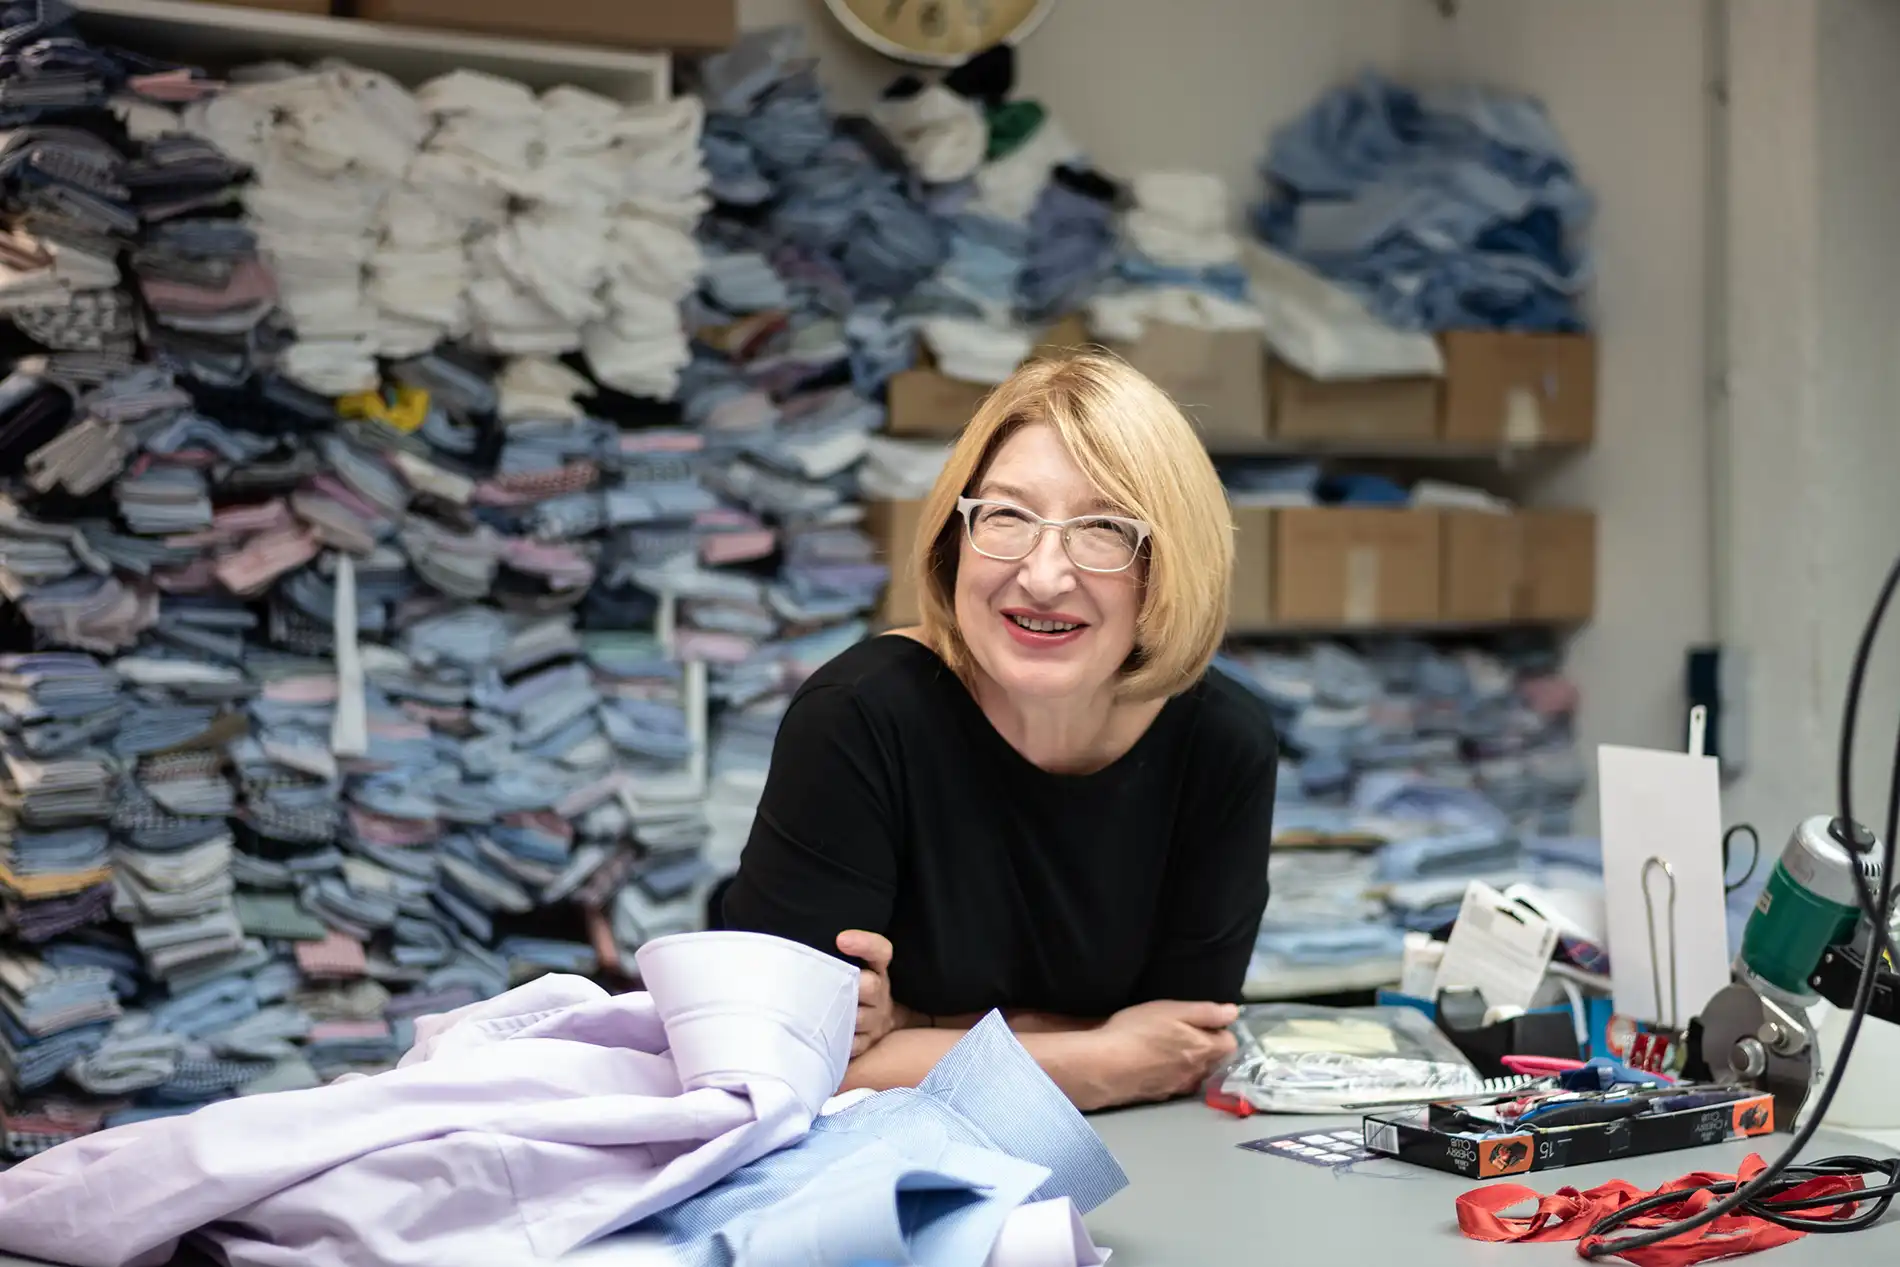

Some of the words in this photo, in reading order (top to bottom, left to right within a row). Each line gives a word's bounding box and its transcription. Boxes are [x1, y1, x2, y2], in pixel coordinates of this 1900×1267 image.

[1450, 1138, 1470, 1150] CLUB
[1540, 1141, 1554, 1159] 15
[1446, 1147, 1476, 1162] CHERRY
